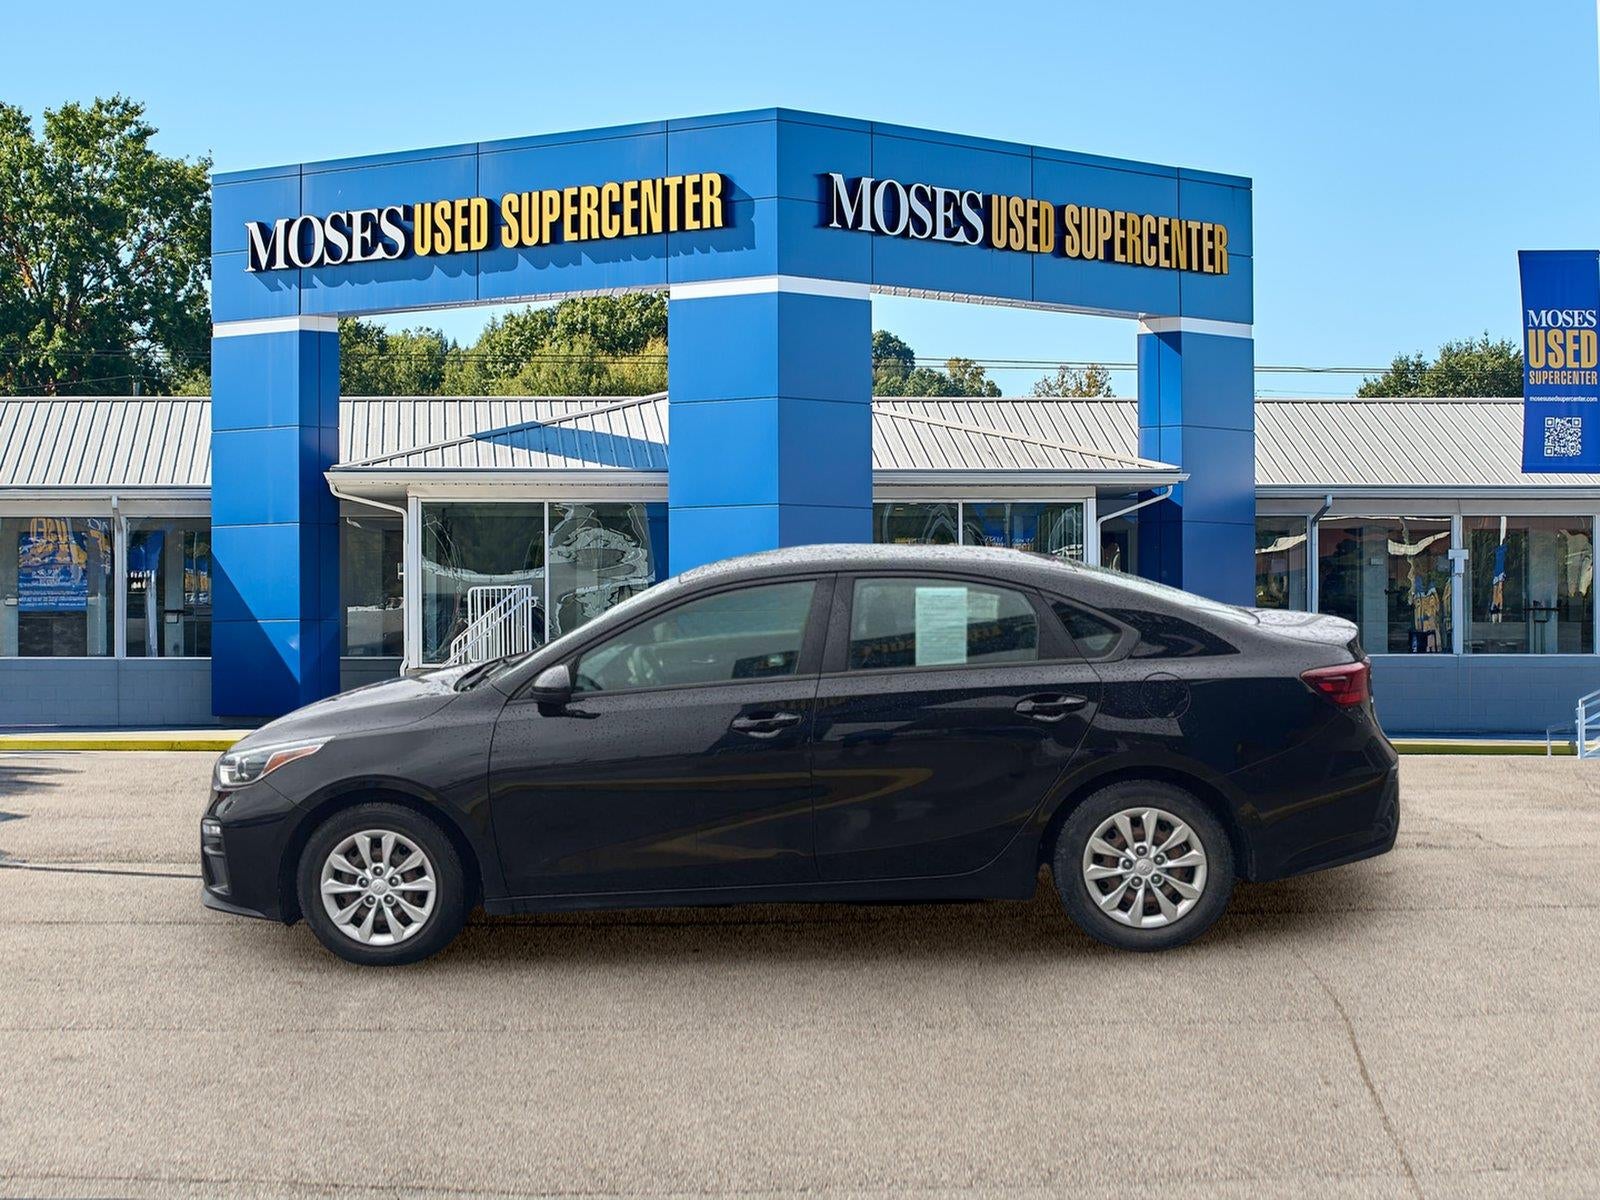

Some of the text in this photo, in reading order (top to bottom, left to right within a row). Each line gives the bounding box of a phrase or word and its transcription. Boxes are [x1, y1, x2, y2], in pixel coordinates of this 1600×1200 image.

[244, 172, 723, 273] MOSES USED SUPERCENTER
[828, 172, 1229, 275] MOSES USED SUPERCENTER
[1527, 309, 1597, 328] MOSES
[1528, 329, 1598, 369] USED
[1529, 370, 1597, 385] SUPERCENTER
